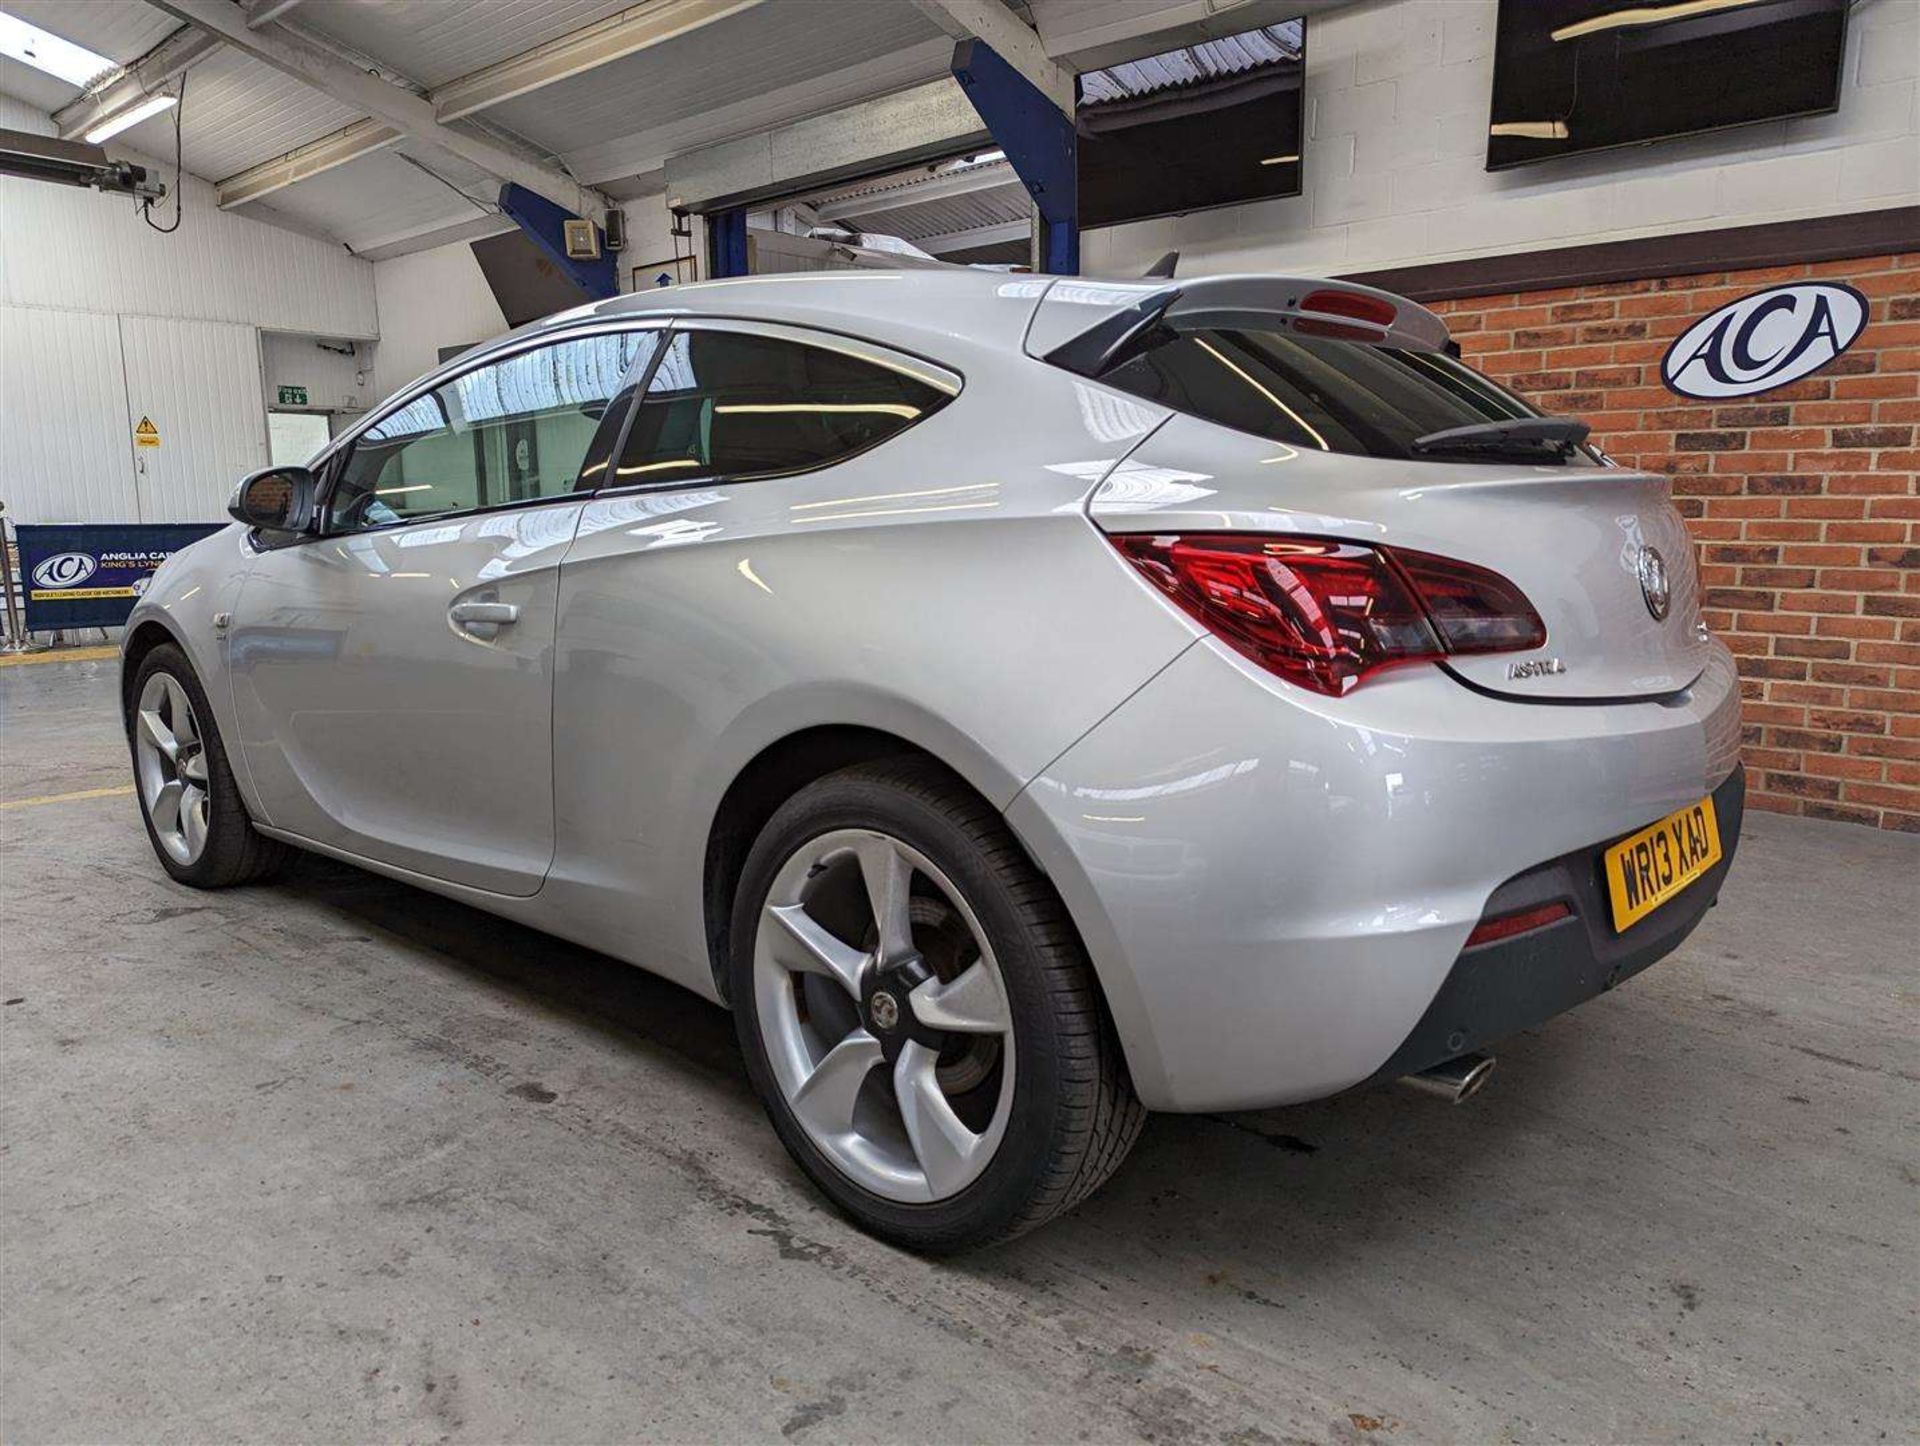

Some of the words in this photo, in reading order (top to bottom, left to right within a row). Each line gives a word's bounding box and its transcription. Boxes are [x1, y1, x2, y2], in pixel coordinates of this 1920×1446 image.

[1669, 293, 1843, 385] ACA
[38, 556, 92, 582] ACA
[100, 552, 147, 561] ANGLIA
[101, 560, 136, 568] KING'S
[1620, 830, 1673, 911] WR13
[1672, 806, 1709, 876] XAD
